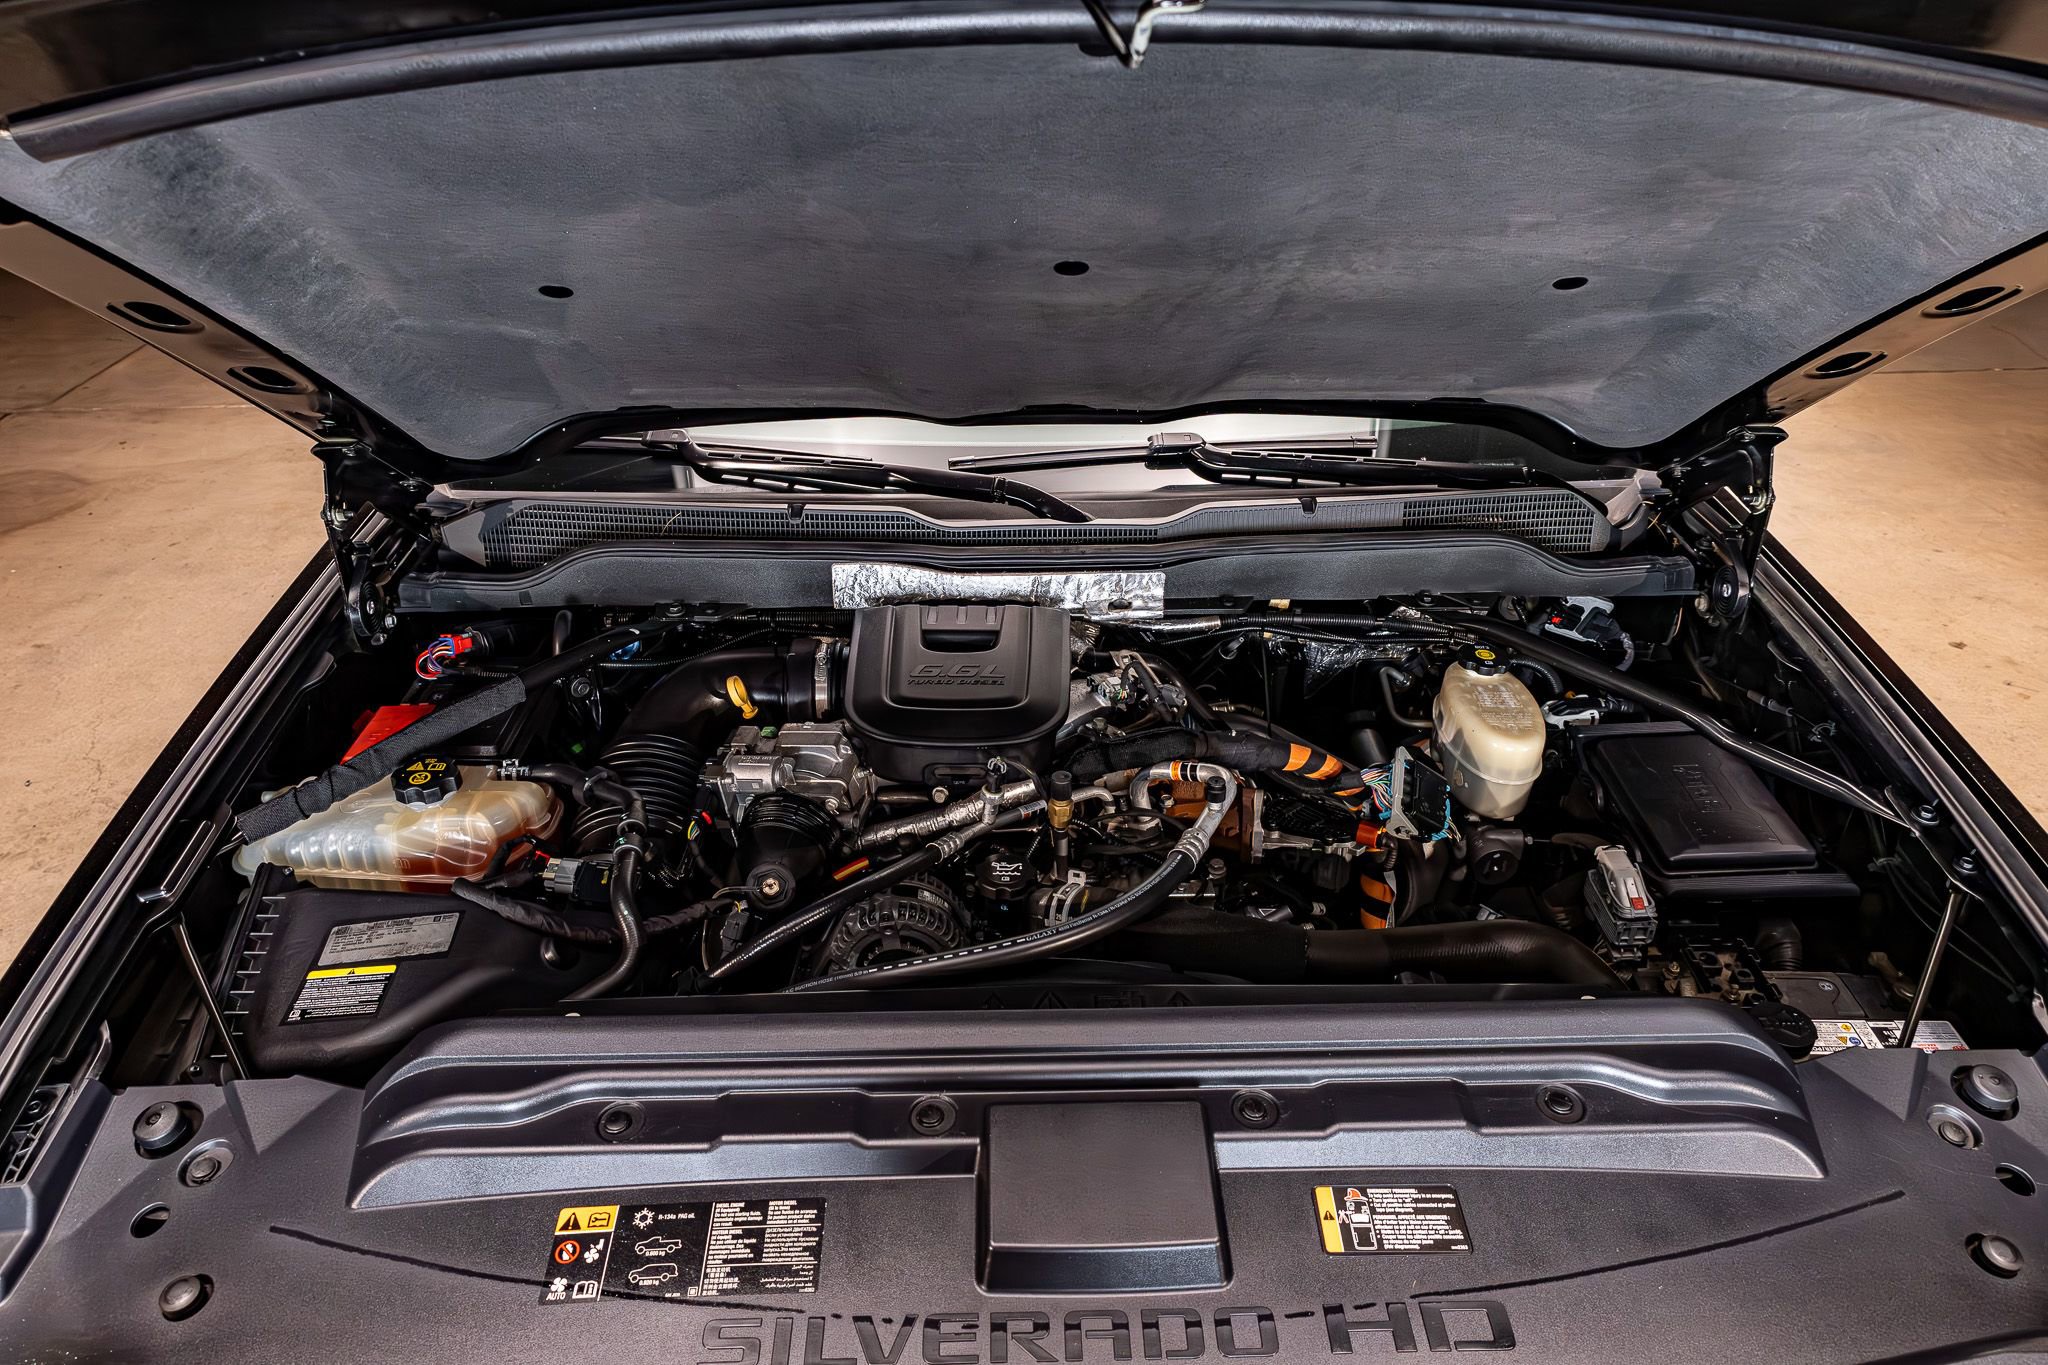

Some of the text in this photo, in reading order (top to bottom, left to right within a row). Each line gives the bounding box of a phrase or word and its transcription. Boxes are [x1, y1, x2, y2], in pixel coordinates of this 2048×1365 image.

[909, 663, 1006, 679] 6.6L
[1026, 928, 1058, 942] GALAXY
[794, 980, 818, 992] SUCTION
[818, 976, 834, 984] HOSE
[546, 1292, 566, 1300] AUTO
[696, 1300, 1517, 1365] SILVERADO HD
